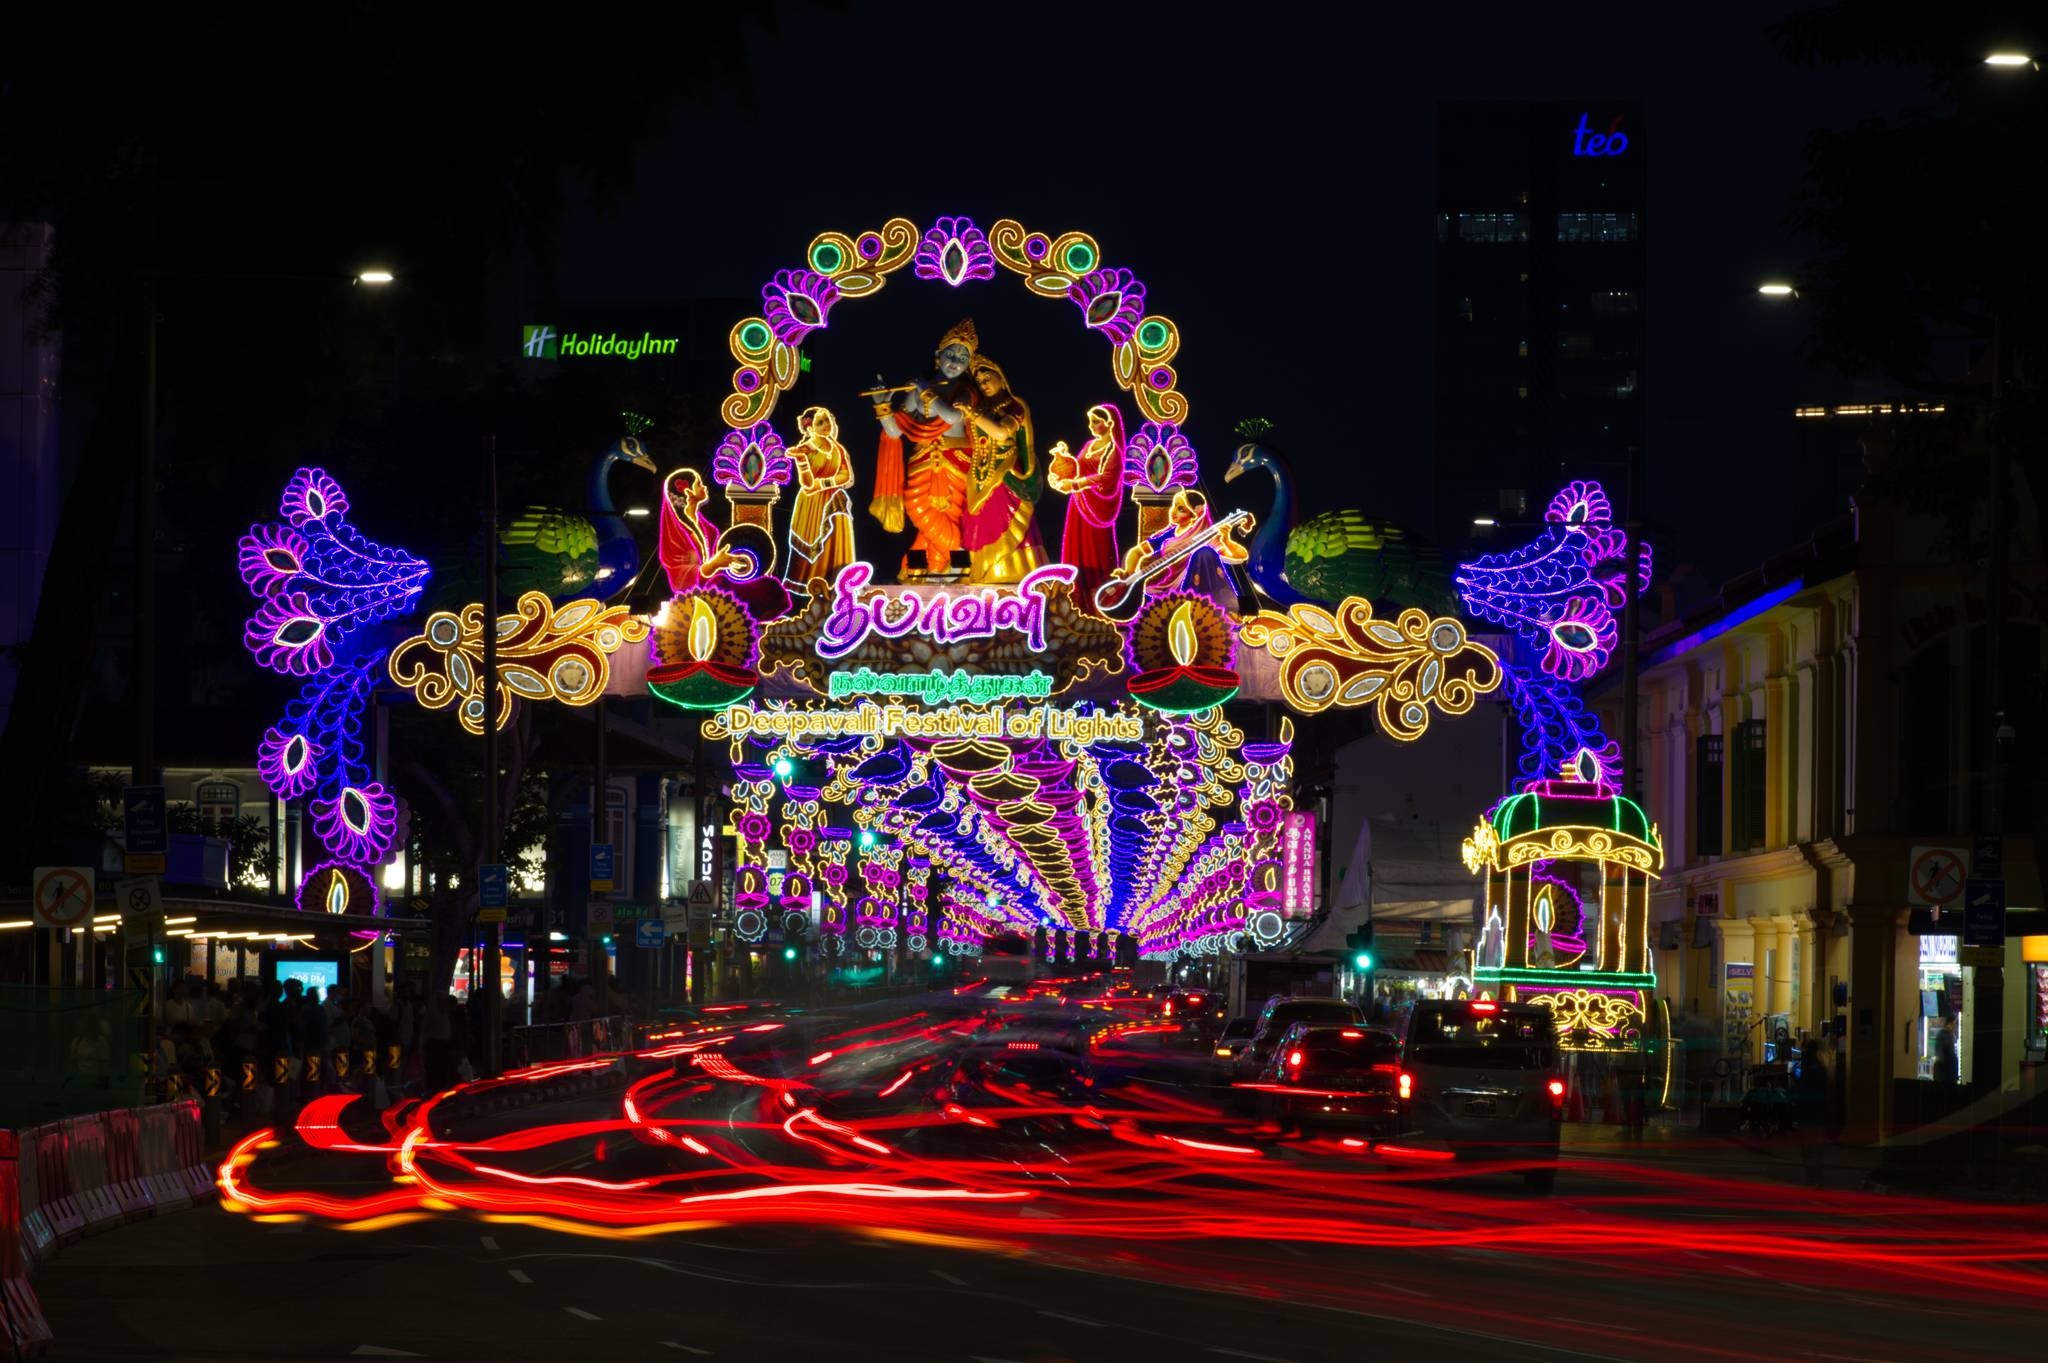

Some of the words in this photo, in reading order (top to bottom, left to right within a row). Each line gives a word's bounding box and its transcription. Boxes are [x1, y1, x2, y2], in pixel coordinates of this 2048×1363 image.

[816, 561, 1078, 657] தீபாவளி
[728, 706, 879, 738] Deepavali
[883, 706, 1002, 737] Festival
[1008, 709, 1044, 736] of
[1048, 710, 1144, 743] Lights
[1303, 827, 1312, 866] ANANDA
[1303, 868, 1312, 908] BHAVAN
[310, 975, 326, 984] PM
